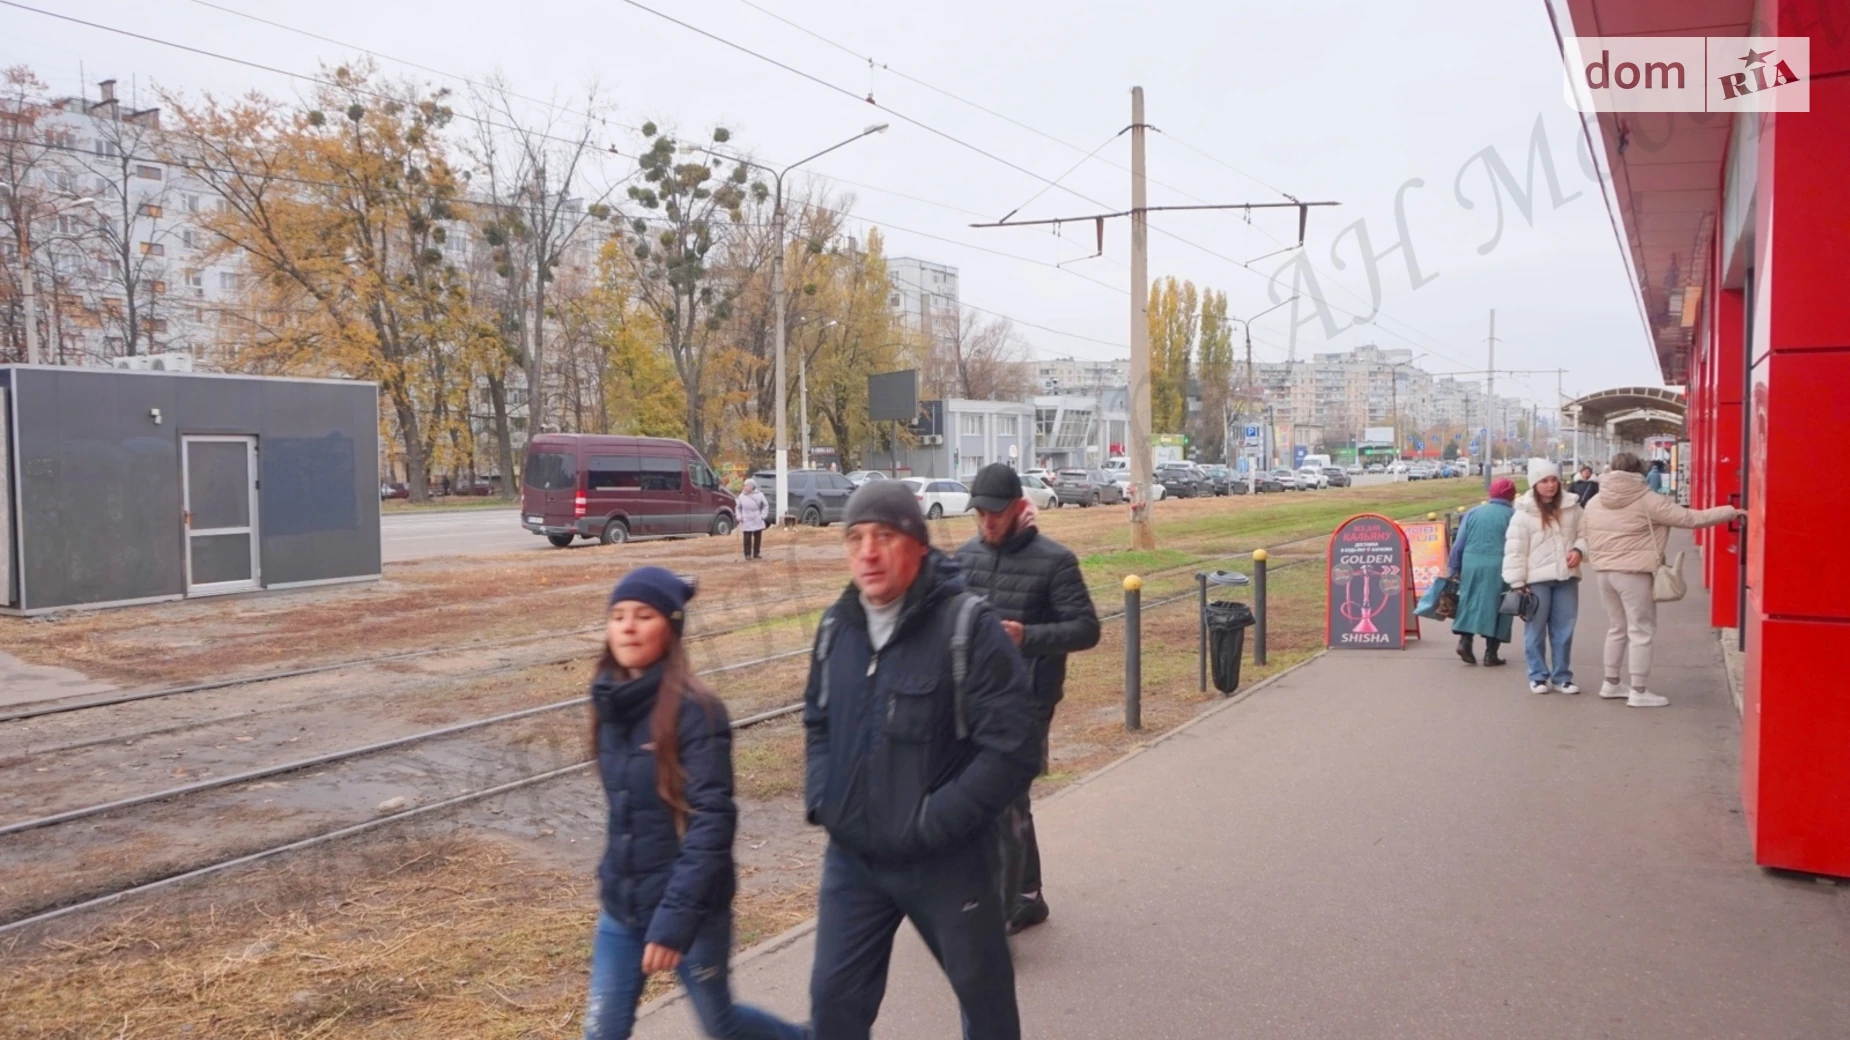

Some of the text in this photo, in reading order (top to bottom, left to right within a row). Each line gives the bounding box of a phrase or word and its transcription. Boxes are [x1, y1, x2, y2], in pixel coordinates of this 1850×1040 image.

[1342, 532, 1392, 542] КАЛЬЯНУ
[1340, 554, 1393, 564] GOLDEN
[1341, 633, 1390, 643] SHISHA
